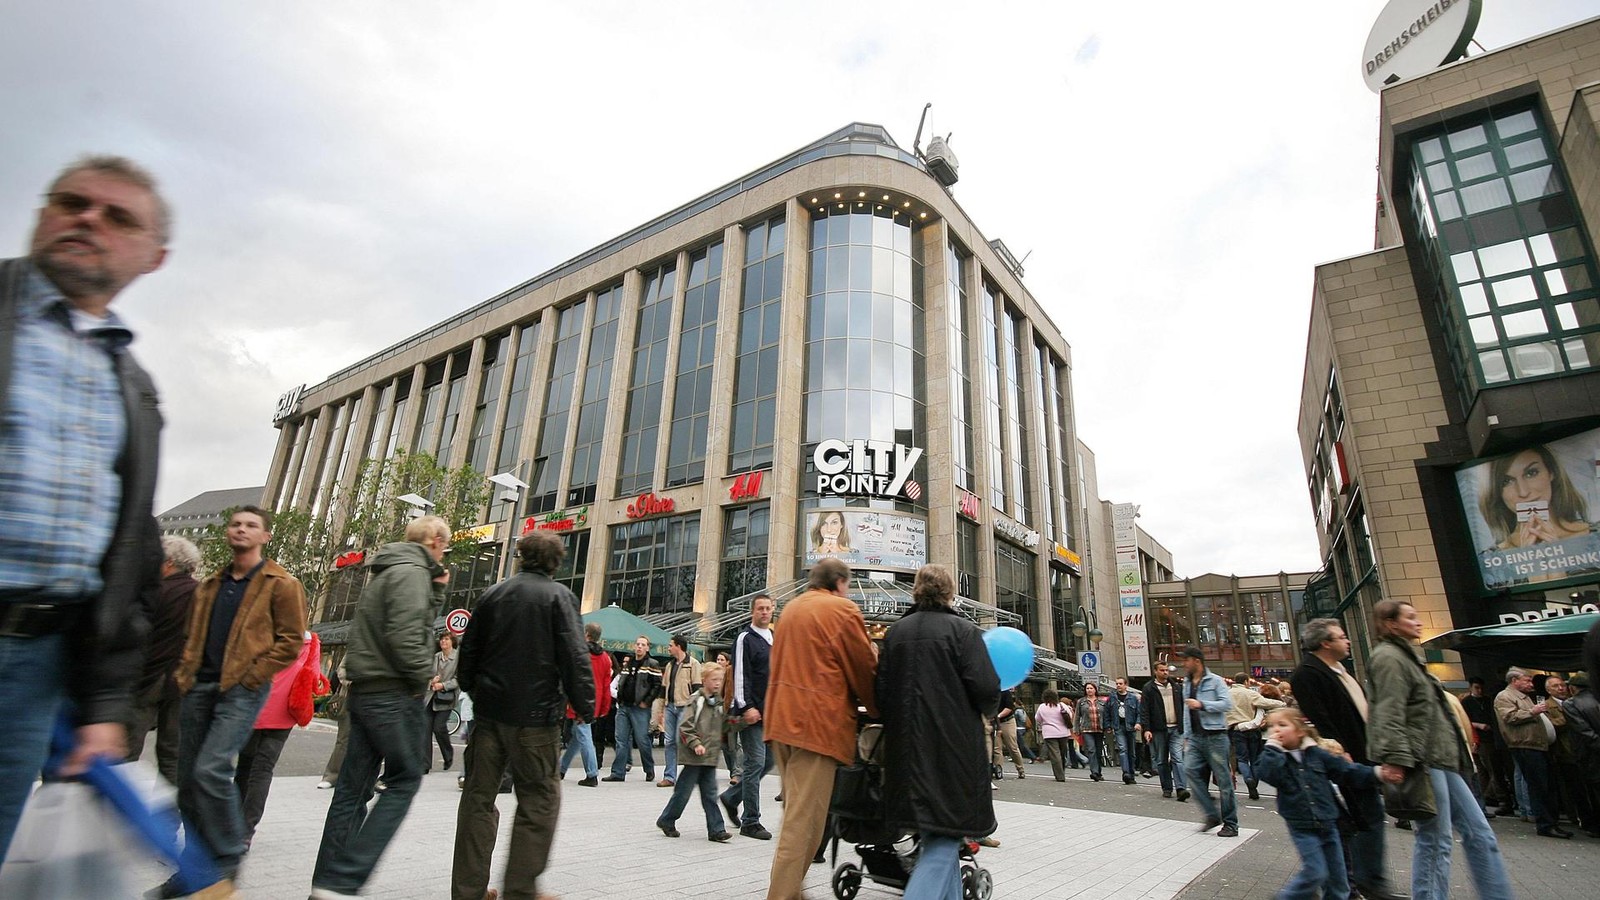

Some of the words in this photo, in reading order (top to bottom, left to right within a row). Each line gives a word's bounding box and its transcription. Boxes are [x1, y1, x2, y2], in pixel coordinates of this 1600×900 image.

[1365, 0, 1460, 75] DREHSCHEIB
[813, 439, 924, 496] CITY
[817, 474, 889, 494] POINT
[1484, 556, 1502, 568] SO
[1505, 545, 1564, 564] EINFACH
[1515, 563, 1534, 575] IST
[1540, 551, 1600, 571] SCHENK
[452, 616, 467, 628] 20
